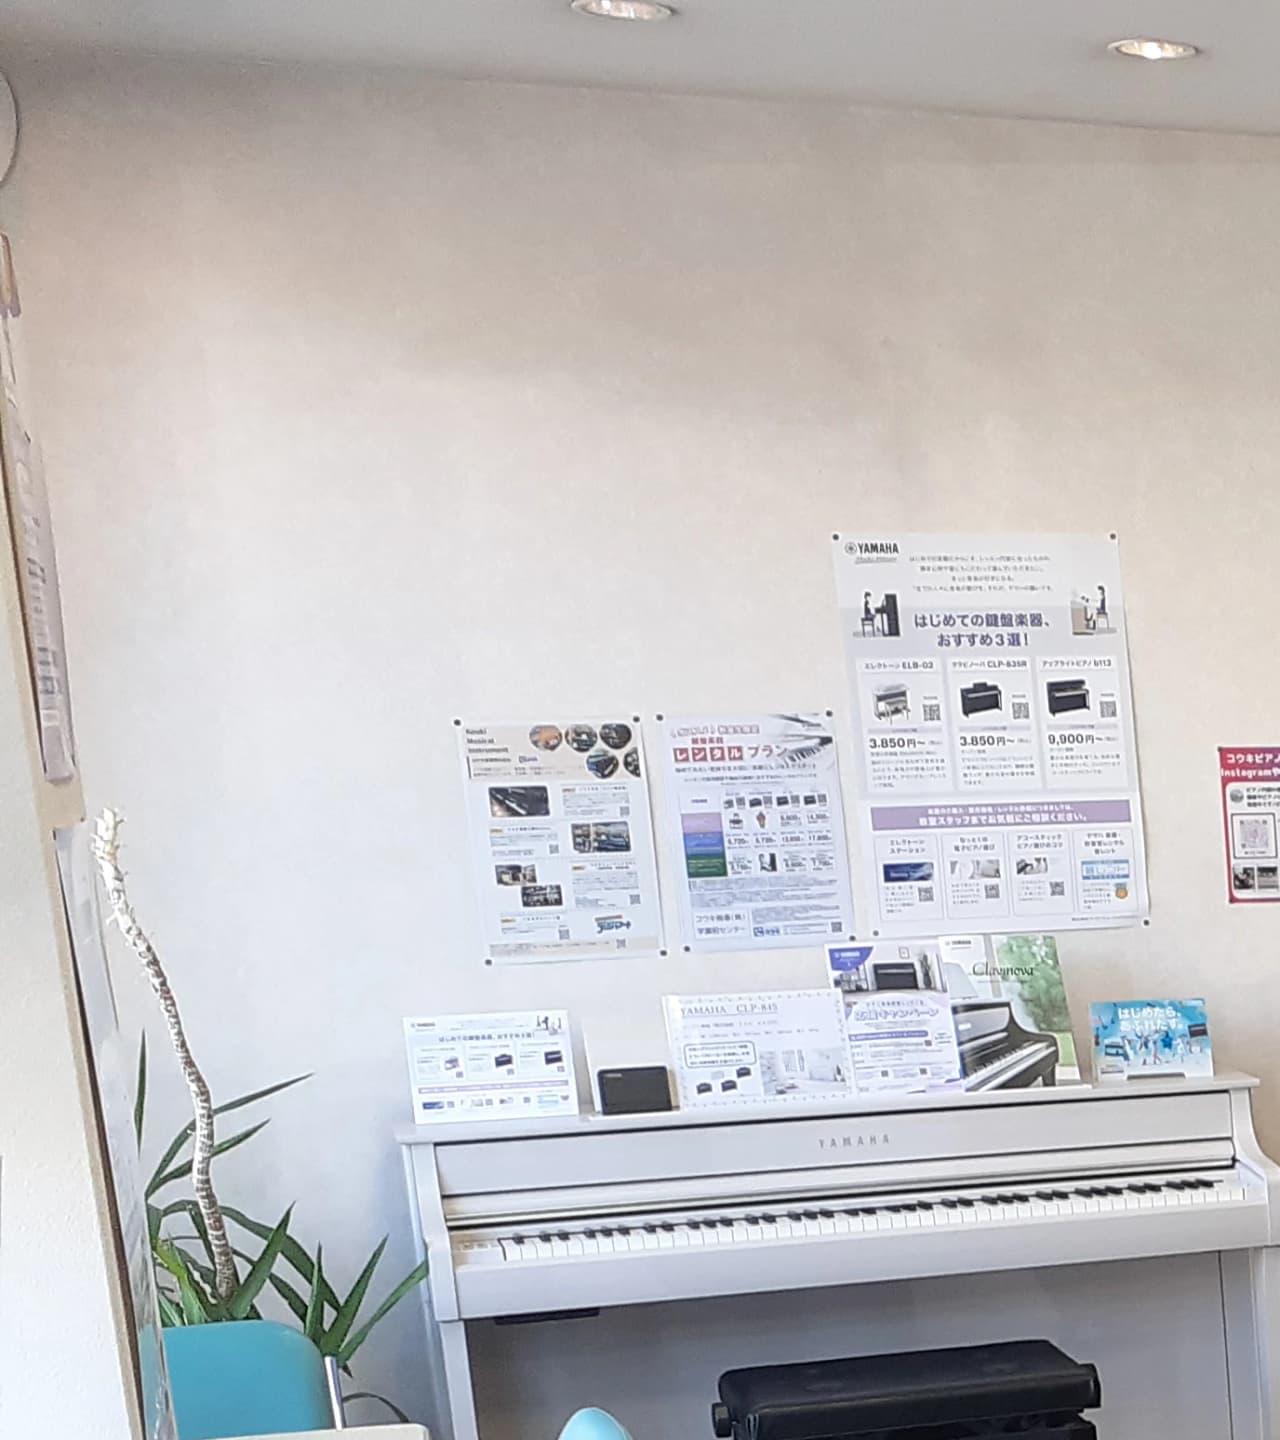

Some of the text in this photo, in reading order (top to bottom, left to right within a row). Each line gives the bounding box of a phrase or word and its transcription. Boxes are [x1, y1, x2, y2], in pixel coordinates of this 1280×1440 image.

[858, 542, 899, 555] YAMAHA
[914, 613, 1050, 629] はじめての鍵盤楽器、
[901, 660, 934, 670] ELB-02
[973, 960, 1034, 977] Clavinova
[680, 1004, 727, 1017] YAMAHA
[819, 1133, 889, 1149] YAMAHA
